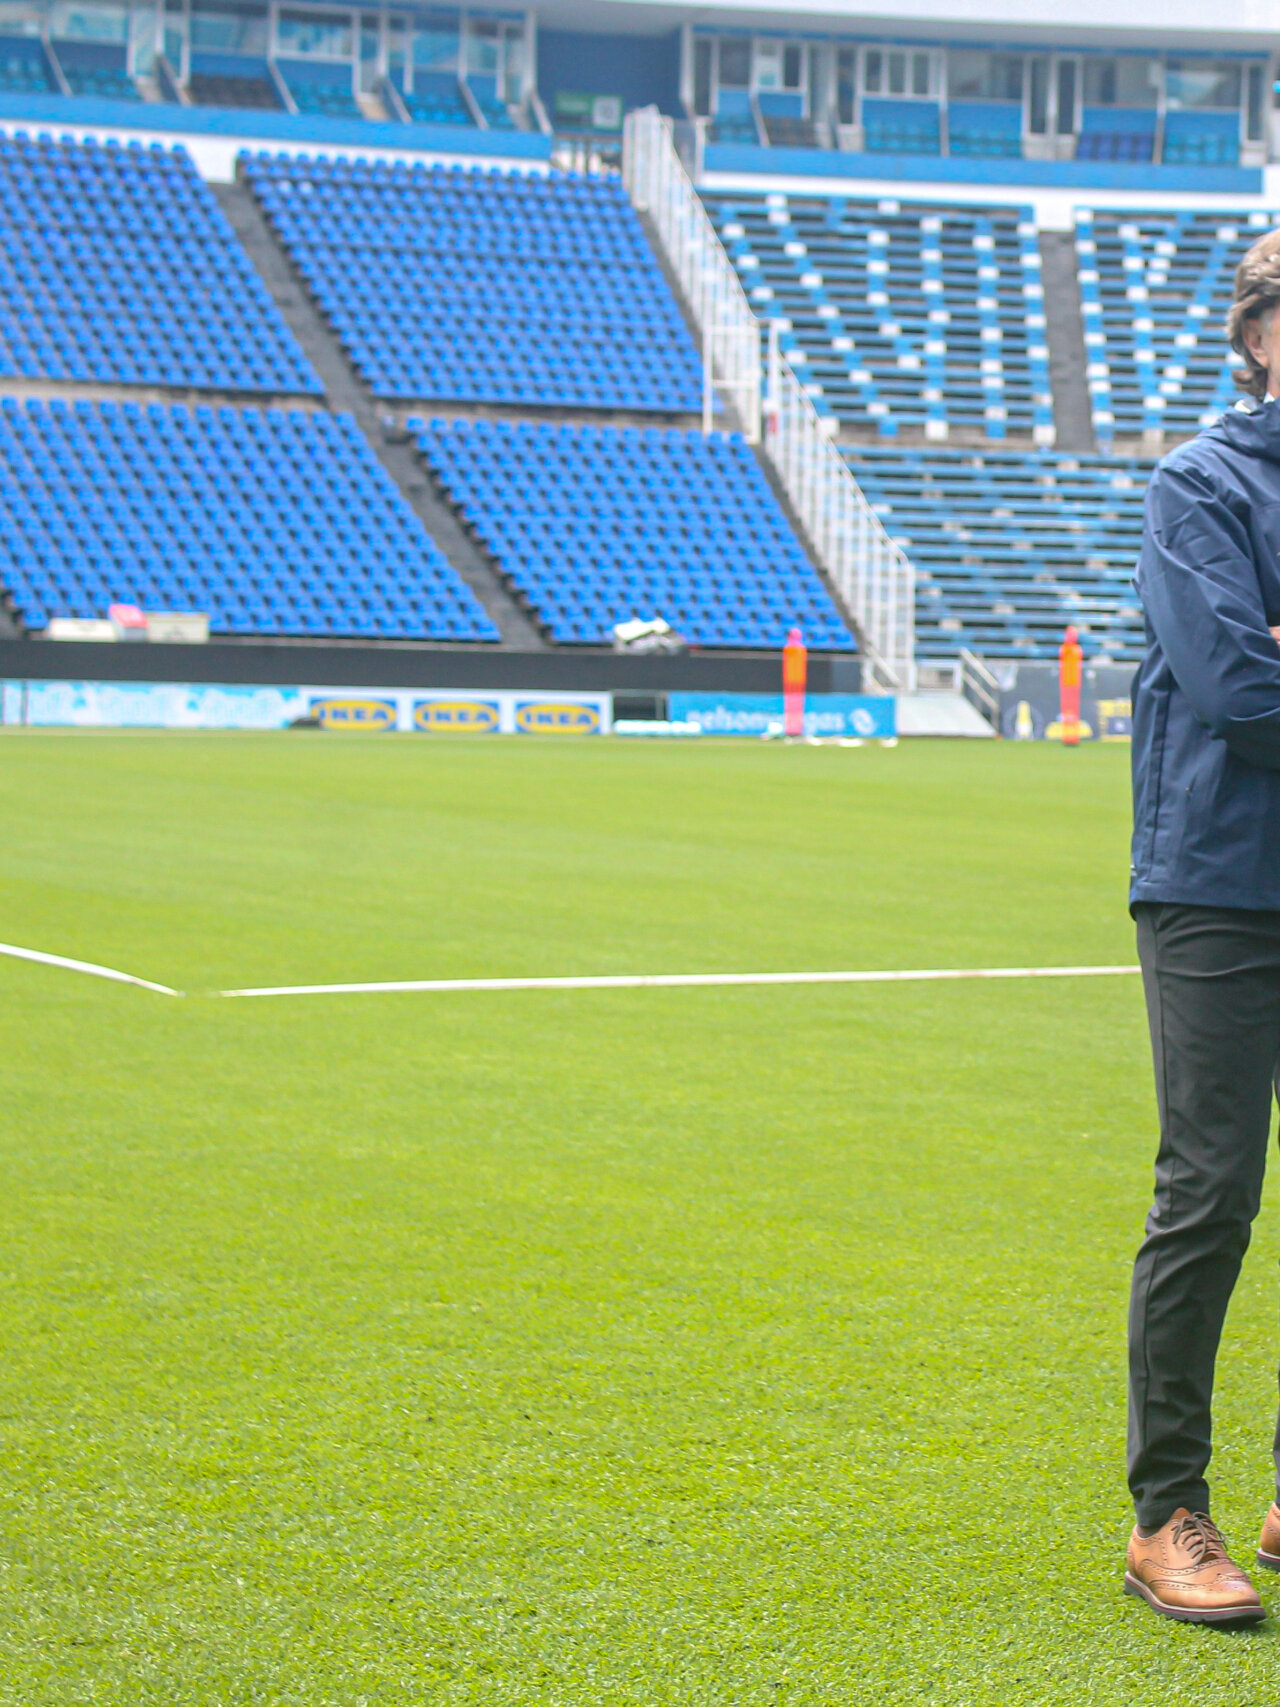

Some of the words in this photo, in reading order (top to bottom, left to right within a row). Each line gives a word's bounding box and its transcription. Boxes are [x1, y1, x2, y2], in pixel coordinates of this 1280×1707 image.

[319, 708, 389, 721] IKEA
[422, 710, 492, 723] IKEA
[525, 713, 593, 725] IKEA
